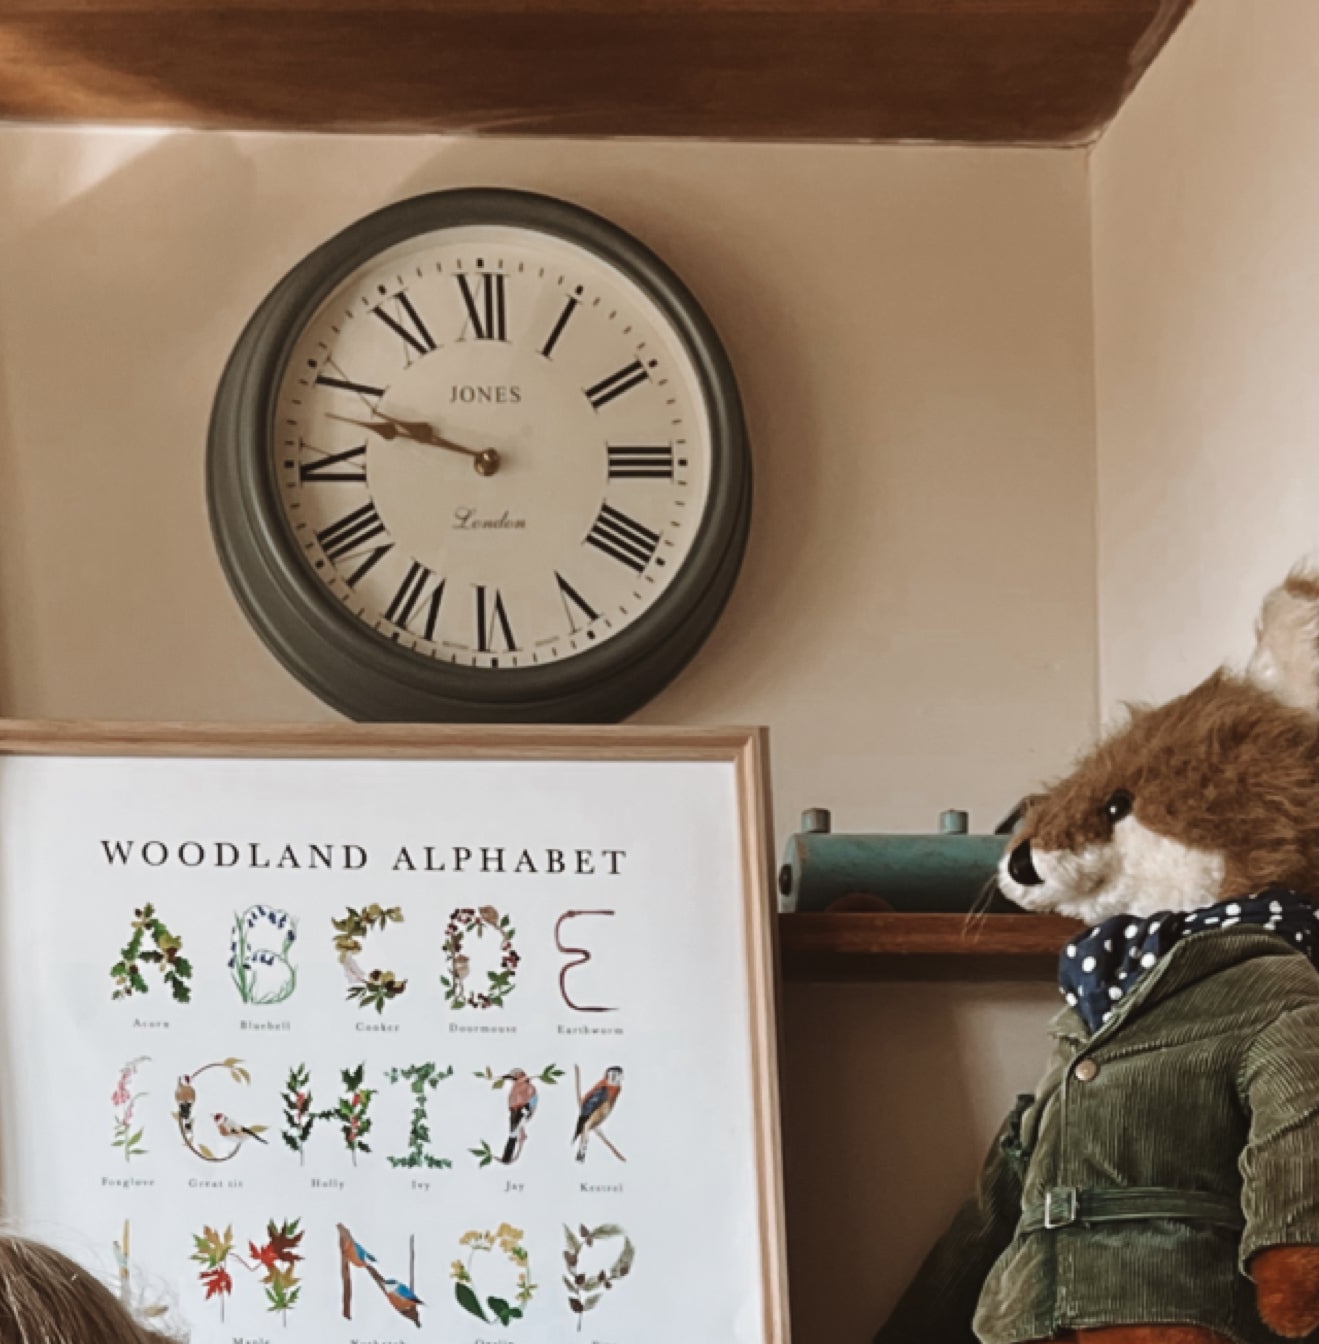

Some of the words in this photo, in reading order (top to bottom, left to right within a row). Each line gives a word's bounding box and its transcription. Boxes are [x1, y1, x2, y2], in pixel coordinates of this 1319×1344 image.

[450, 386, 521, 404] JONES
[452, 507, 526, 530] London
[100, 840, 367, 870] WOODLAND
[392, 847, 626, 874] ALPHABET
[132, 1017, 171, 1029] Acorn
[239, 1019, 291, 1032] Bluebell
[556, 1023, 625, 1036] Earthworm
[100, 1176, 156, 1189] Foxglove
[187, 1177, 224, 1189] Great
[310, 1177, 345, 1191] Holly
[410, 1179, 432, 1193] Ivy
[503, 1179, 525, 1193] Jay
[579, 1182, 624, 1193] Kestrel
